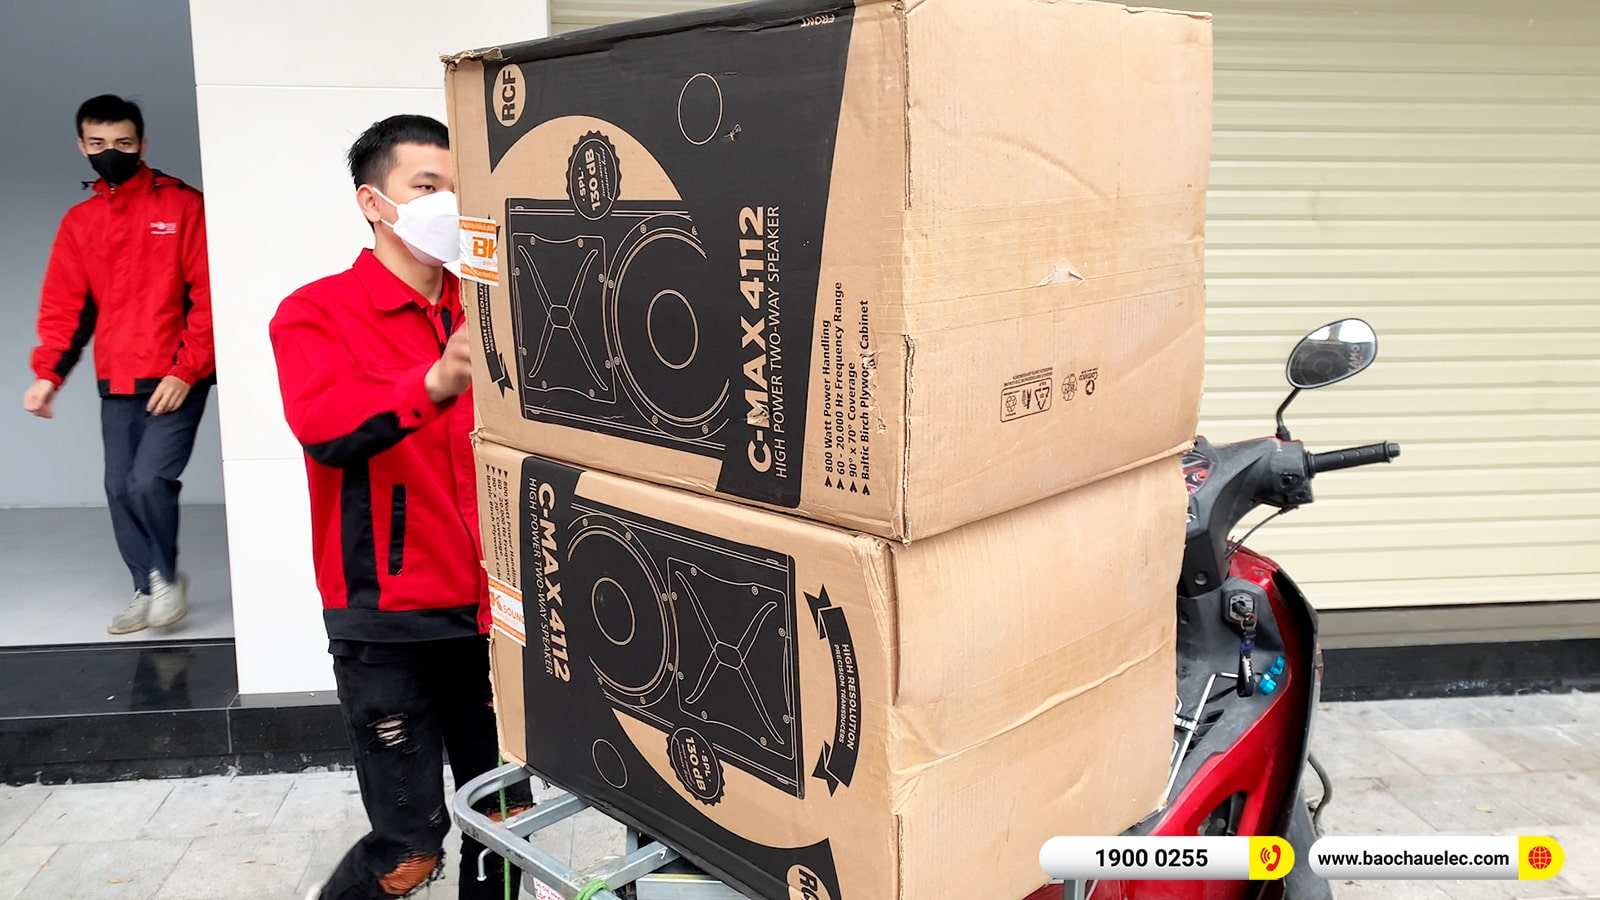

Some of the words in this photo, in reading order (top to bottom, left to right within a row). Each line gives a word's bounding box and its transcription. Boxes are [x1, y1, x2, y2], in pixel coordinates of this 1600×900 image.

[800, 14, 835, 28] FRONT
[501, 69, 517, 122] RCF
[585, 148, 596, 176] dB
[578, 171, 586, 197] SPL
[588, 177, 600, 211] 130
[738, 206, 765, 310] 4112
[767, 206, 780, 282] SPEAKER
[833, 282, 844, 322] Range
[482, 329, 490, 354] HIGH
[768, 286, 782, 371] TWO-WAY
[858, 300, 869, 350] Cabinet
[821, 320, 832, 375] Handling
[834, 326, 845, 390] Frequency
[740, 316, 774, 474] C-MAX
[771, 374, 785, 434] POWER
[823, 378, 832, 418] Power
[835, 392, 844, 408] Hz
[846, 362, 858, 421] Coverage
[824, 422, 833, 449] Watt
[836, 411, 844, 450] 20.000
[848, 423, 857, 444] 70°
[860, 412, 870, 442] Birch
[774, 438, 788, 478] HIGH
[824, 452, 834, 473] 800
[836, 460, 846, 476] 60
[848, 457, 858, 478] 90°
[850, 446, 857, 455] x
[860, 446, 870, 480] Baltic
[528, 477, 538, 510] HIGH
[502, 526, 506, 536] Hz
[530, 513, 542, 558] POWER
[538, 482, 562, 608] C-MAX
[534, 561, 548, 620] TWO-WAY
[540, 622, 553, 675] SPEAKER
[549, 608, 571, 683] 4112
[842, 644, 854, 674] HIGH
[834, 644, 846, 687] PRECISION
[838, 688, 846, 744] TRANSDUCERS
[847, 676, 857, 750] RESOLUTION
[686, 736, 699, 766] 130
[702, 754, 711, 778] SPL
[692, 768, 706, 790] dB
